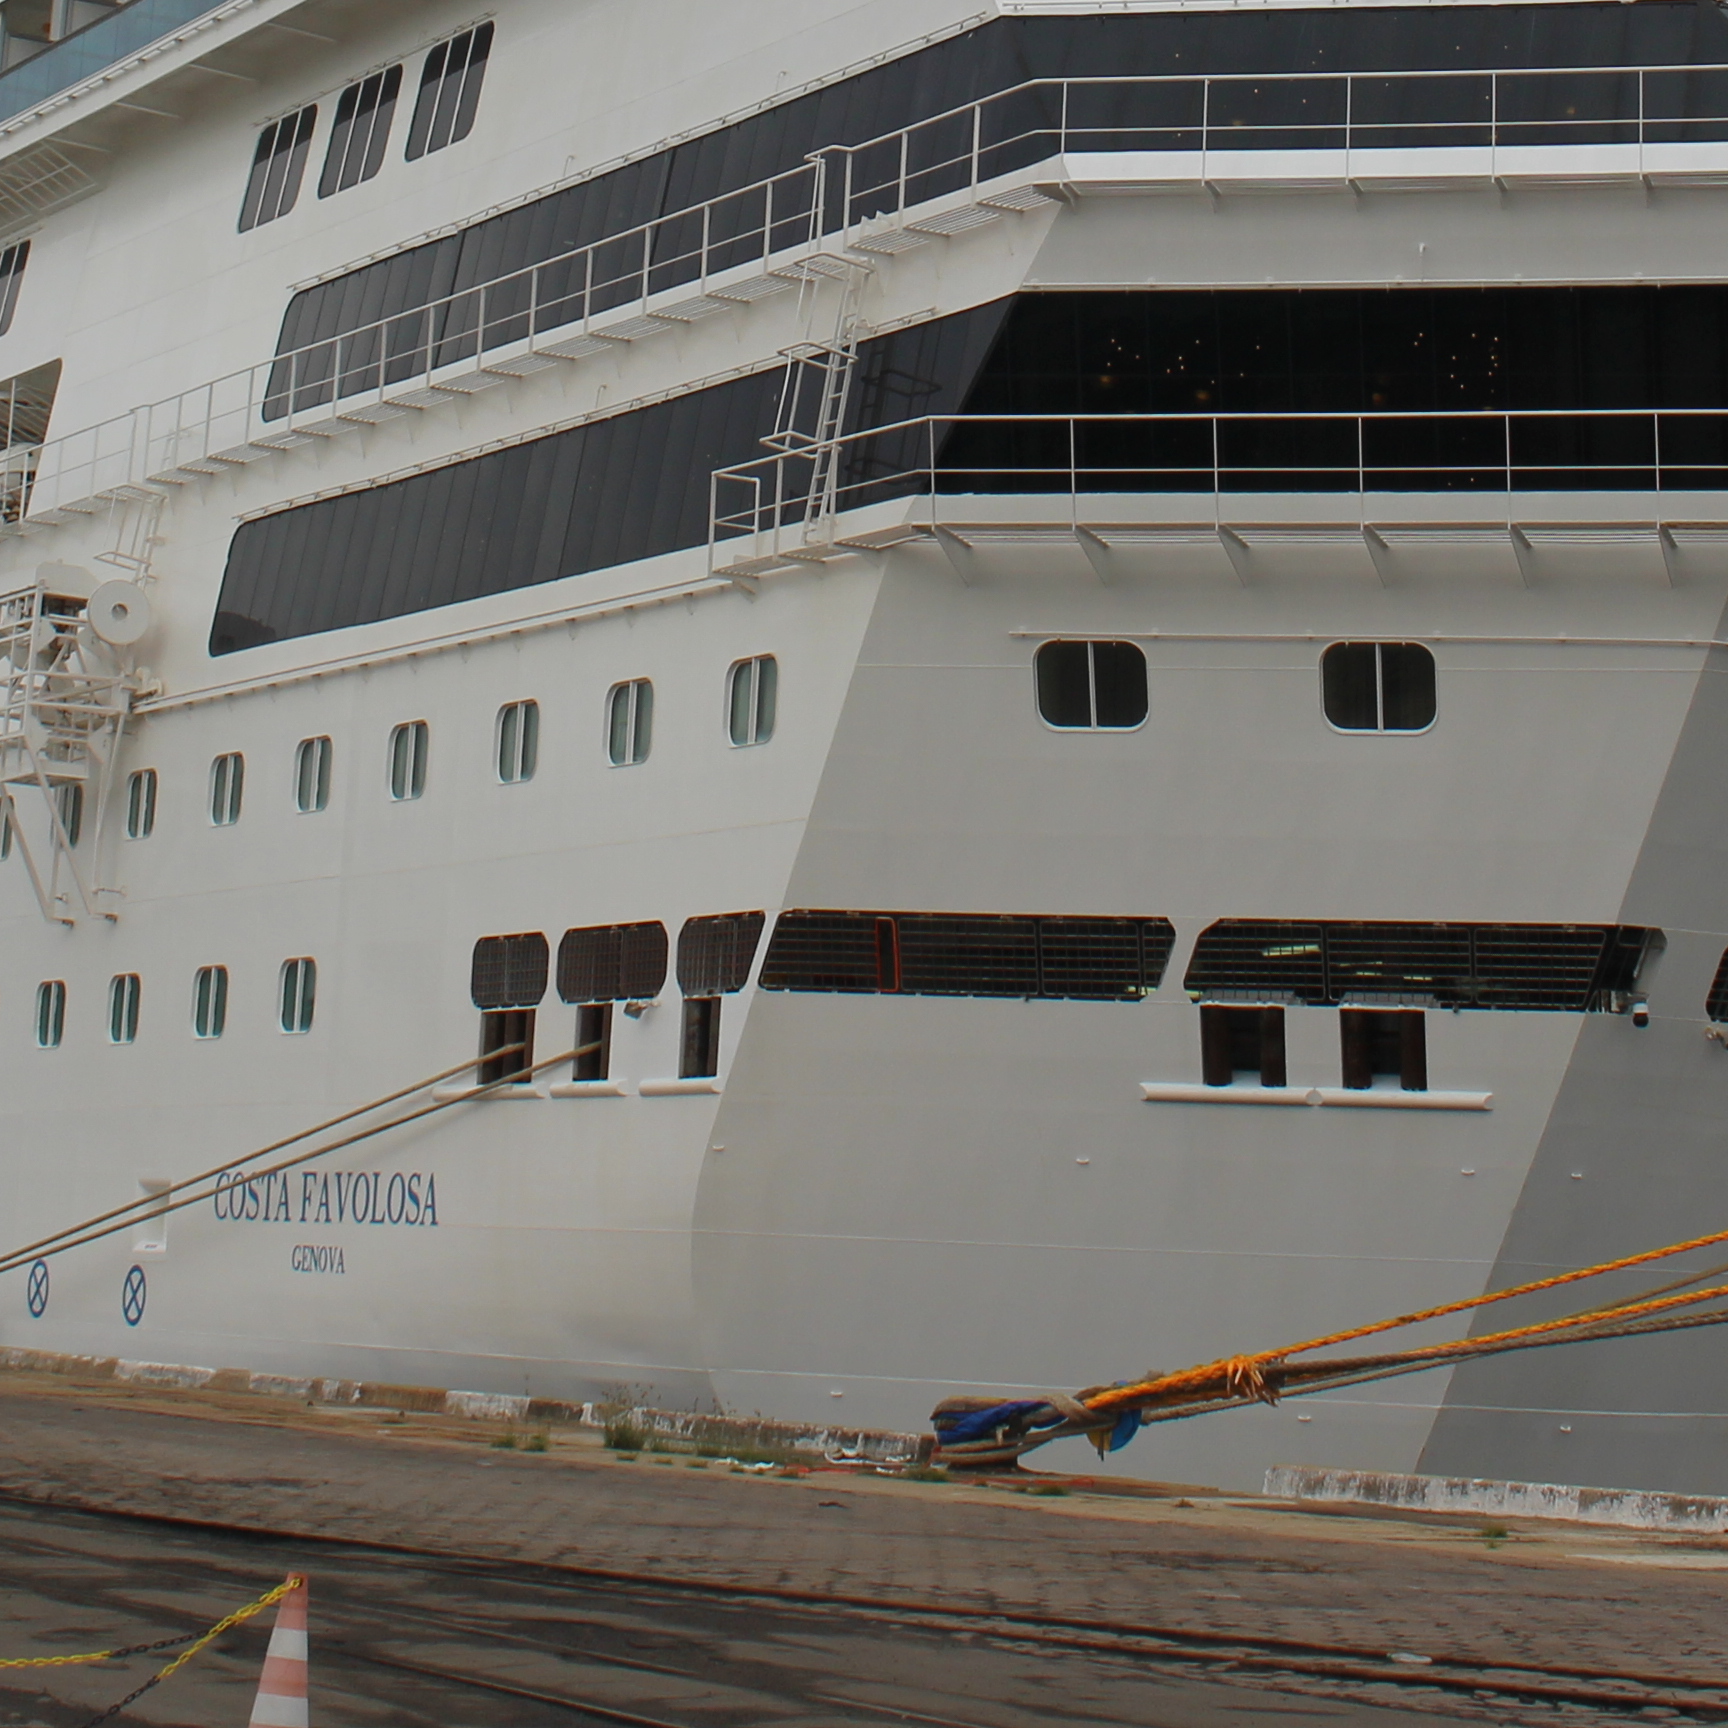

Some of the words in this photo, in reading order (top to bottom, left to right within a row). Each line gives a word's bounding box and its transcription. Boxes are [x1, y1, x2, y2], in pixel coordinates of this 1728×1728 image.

[214, 1171, 291, 1222] COSTA
[299, 1171, 439, 1226] FAVOLOSA
[291, 1244, 346, 1274] GENOVA
